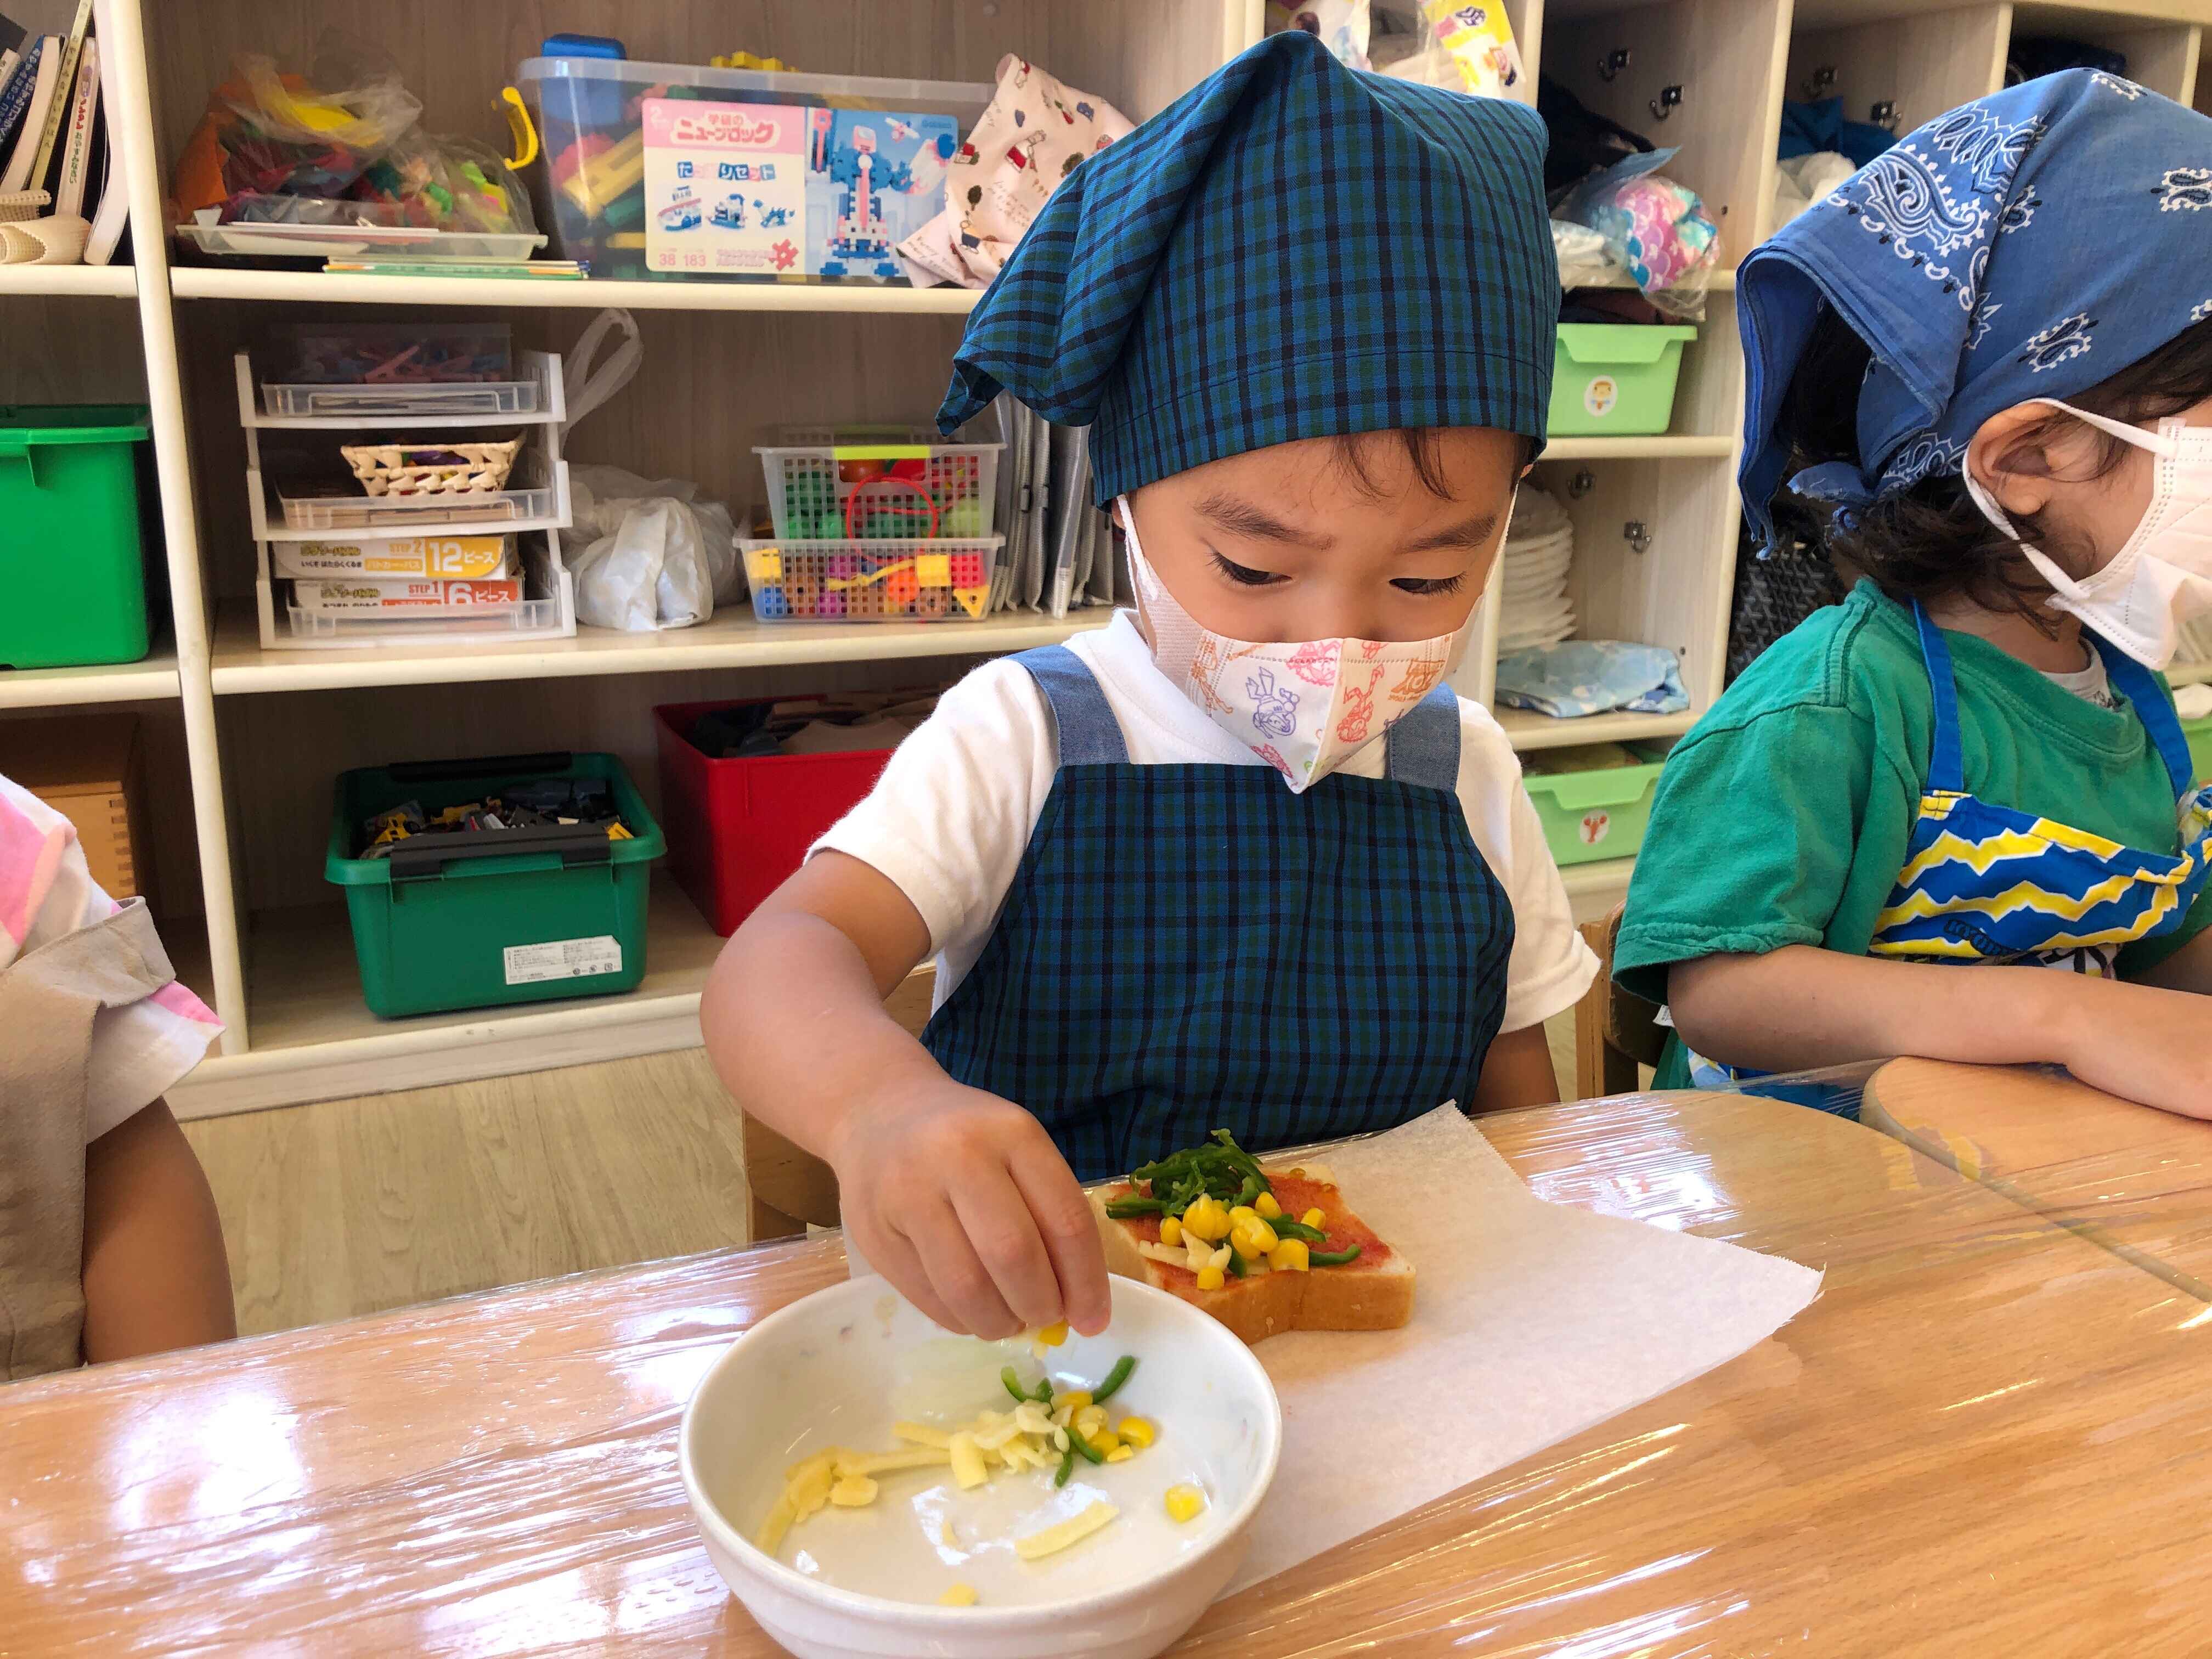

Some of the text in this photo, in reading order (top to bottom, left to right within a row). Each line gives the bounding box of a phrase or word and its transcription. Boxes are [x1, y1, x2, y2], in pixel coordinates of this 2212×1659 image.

[677, 119, 774, 144] ニューブロック
[659, 253, 676, 266] 38
[684, 254, 707, 267] 183
[389, 539, 422, 555] STEP 2
[409, 581, 439, 594] STEP 1
